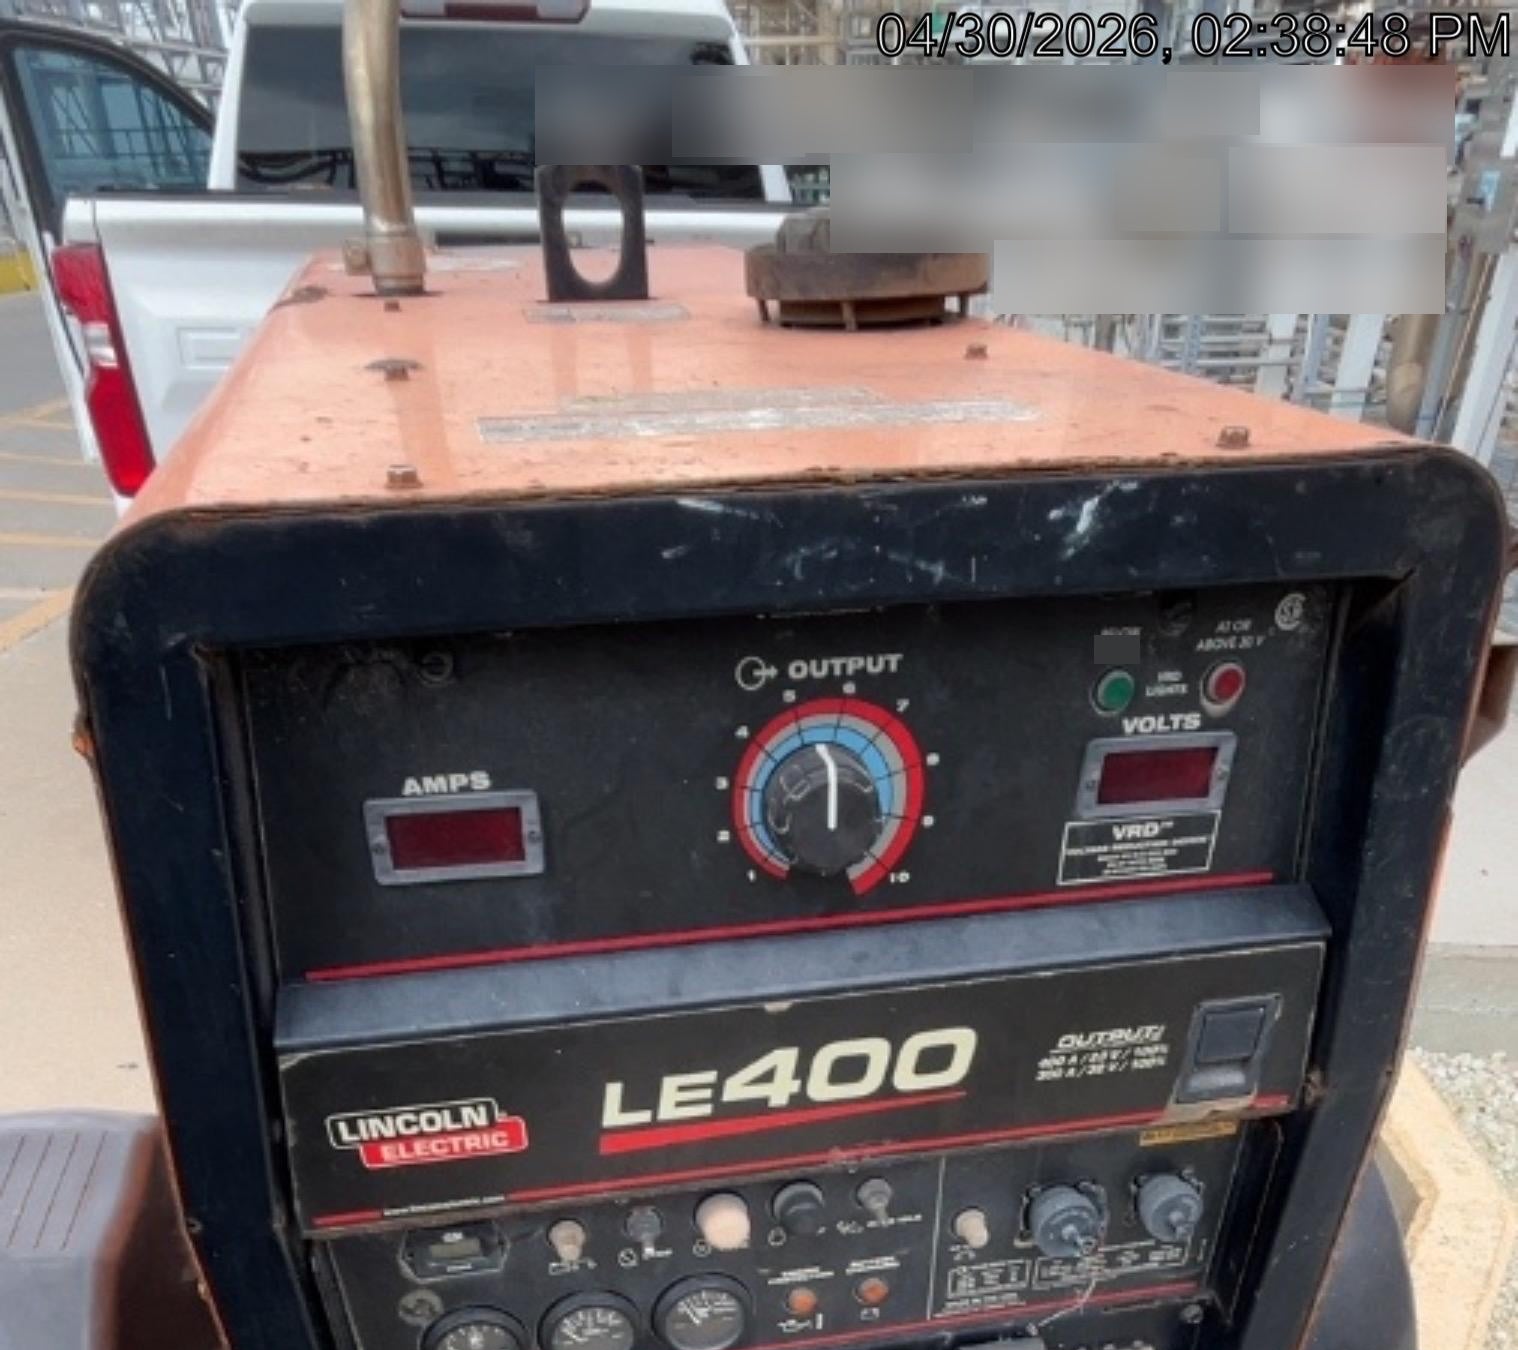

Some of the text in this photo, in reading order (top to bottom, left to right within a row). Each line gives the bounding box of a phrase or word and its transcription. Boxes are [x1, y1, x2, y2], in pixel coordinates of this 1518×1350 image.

[787, 653, 903, 679] OUTPUT
[1121, 713, 1201, 735] VOLTS
[402, 770, 492, 797] AMPS
[602, 1026, 978, 1129] LE400
[337, 1103, 489, 1142] LINCOLN
[380, 1130, 511, 1162] ELECTRIC
